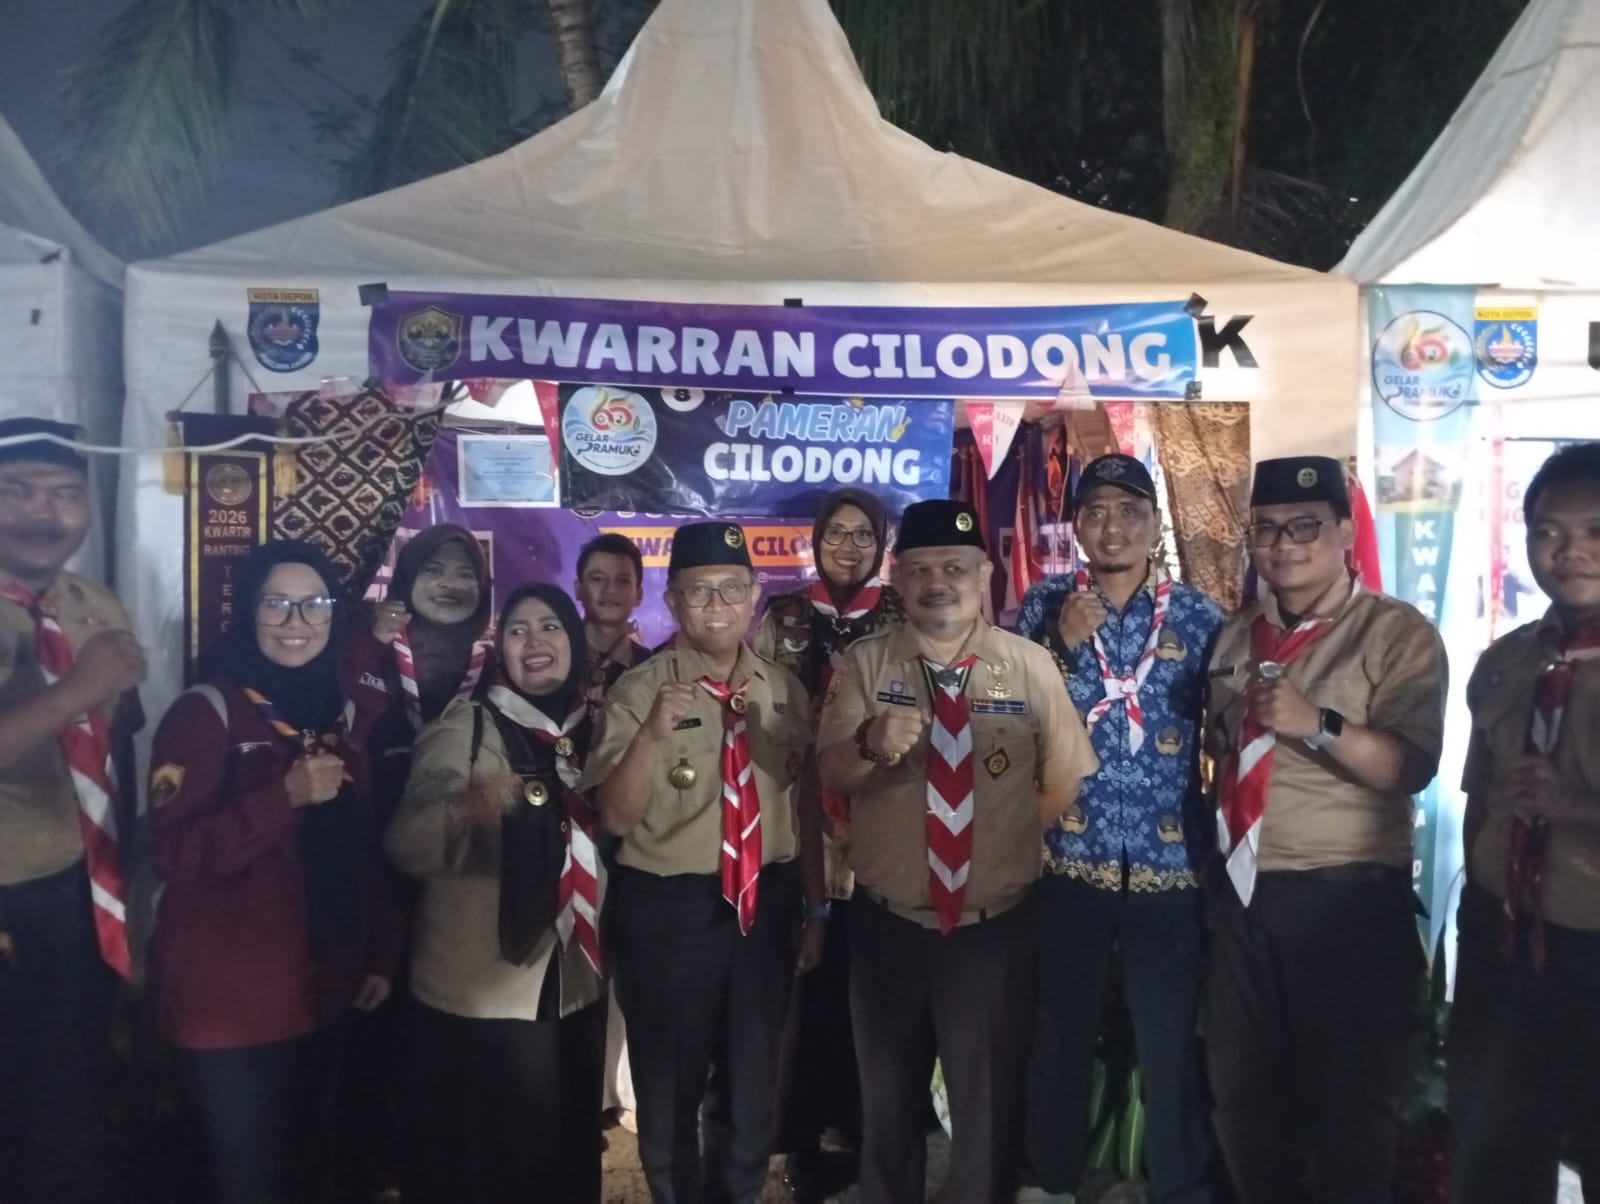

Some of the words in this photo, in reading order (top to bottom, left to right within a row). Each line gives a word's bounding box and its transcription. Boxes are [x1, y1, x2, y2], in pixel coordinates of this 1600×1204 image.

[469, 315, 816, 378] KWARRAN
[832, 332, 1171, 380] CILODONG
[1384, 375, 1420, 385] GELAR
[724, 400, 906, 442] PAMERAN
[575, 433, 609, 443] GELAR
[703, 441, 921, 485] CILODONG
[208, 510, 247, 524] 2026
[204, 526, 252, 539] KWARTIR
